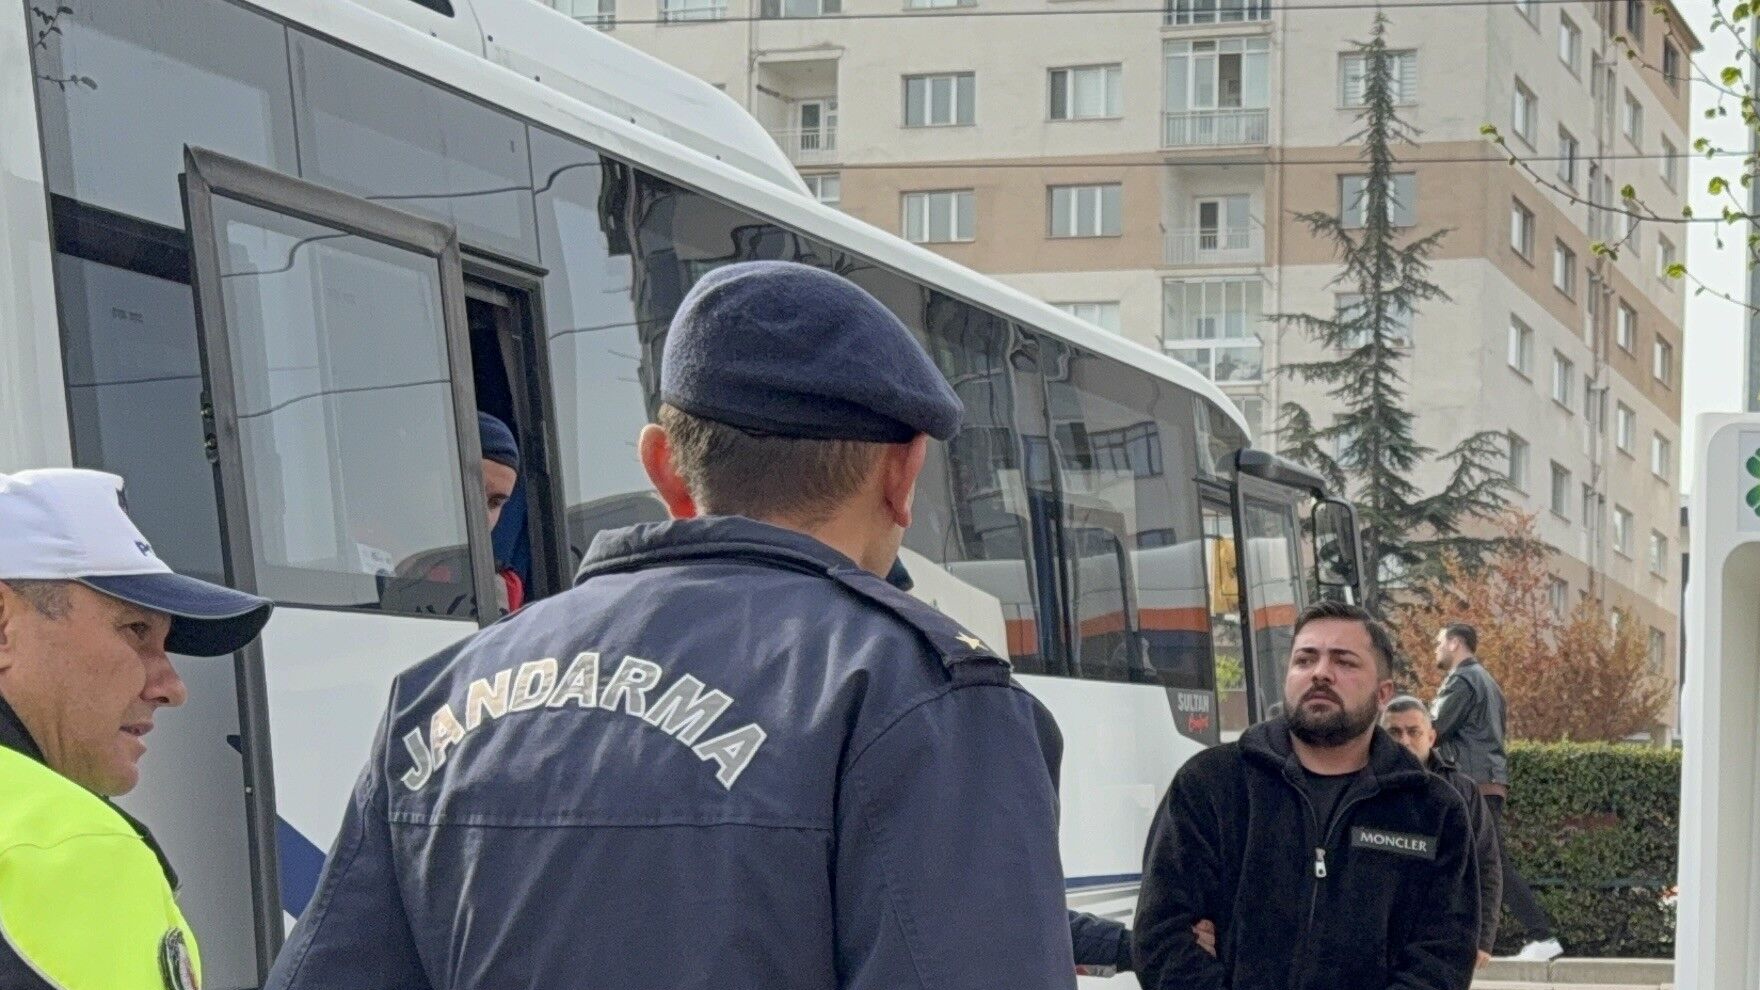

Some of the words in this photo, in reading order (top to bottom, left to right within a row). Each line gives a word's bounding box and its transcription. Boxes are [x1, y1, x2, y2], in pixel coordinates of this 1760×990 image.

[1177, 691, 1210, 713] SULTAN
[401, 652, 768, 790] JANDARMA
[1360, 831, 1427, 853] MONCLER
